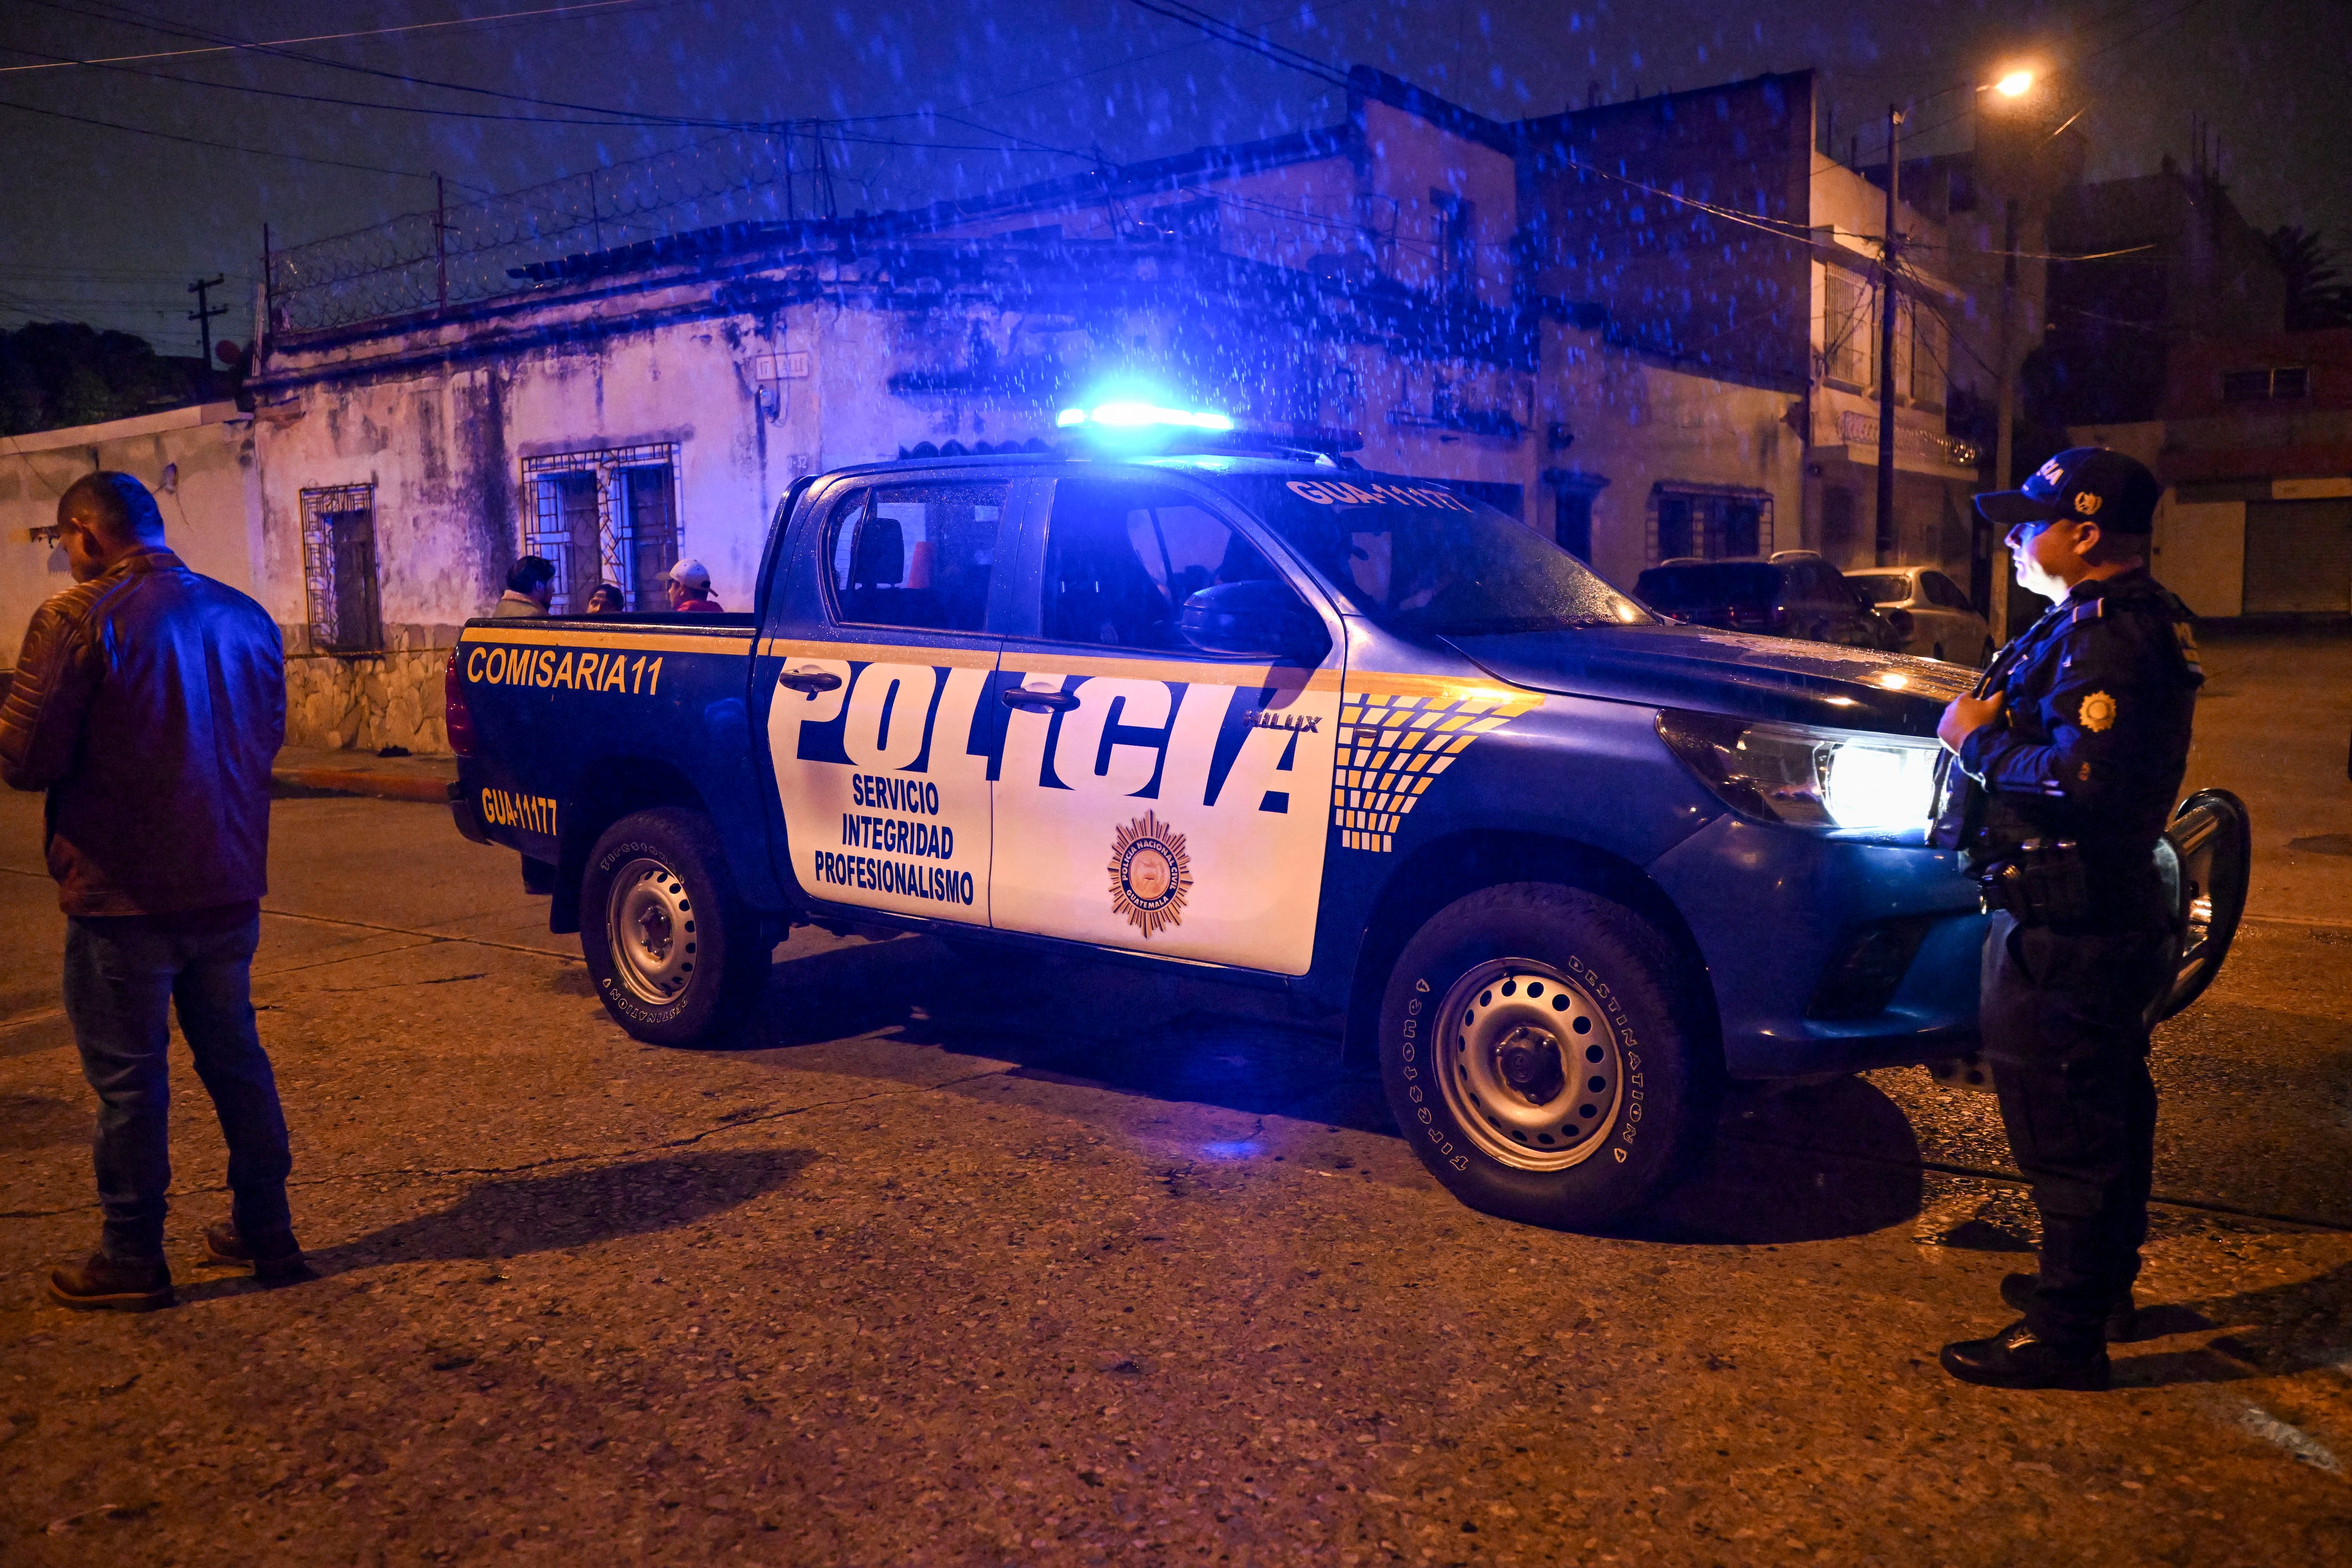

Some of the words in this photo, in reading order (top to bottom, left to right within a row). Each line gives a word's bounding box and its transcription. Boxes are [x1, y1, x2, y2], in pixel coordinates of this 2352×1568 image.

[1286, 481, 1473, 513] GUA-11177
[467, 647, 626, 693] COMISARIA
[630, 656, 663, 695] 11
[768, 657, 1319, 814] POLICIA
[1243, 710, 1323, 733] HILUX
[482, 788, 557, 836] GUA-11177
[852, 773, 939, 816] SERVICIO
[842, 813, 954, 860] INTEGRIDAD
[815, 850, 974, 906] PROFESIONALISMO
[1122, 847, 1137, 881] POLICIA
[1136, 840, 1175, 867] NACIONAL
[1169, 867, 1178, 890] CIVIL
[1126, 889, 1169, 909] GUATEMALA
[610, 988, 688, 1023] DESTINATION
[1568, 955, 1644, 1144] DESTINATION
